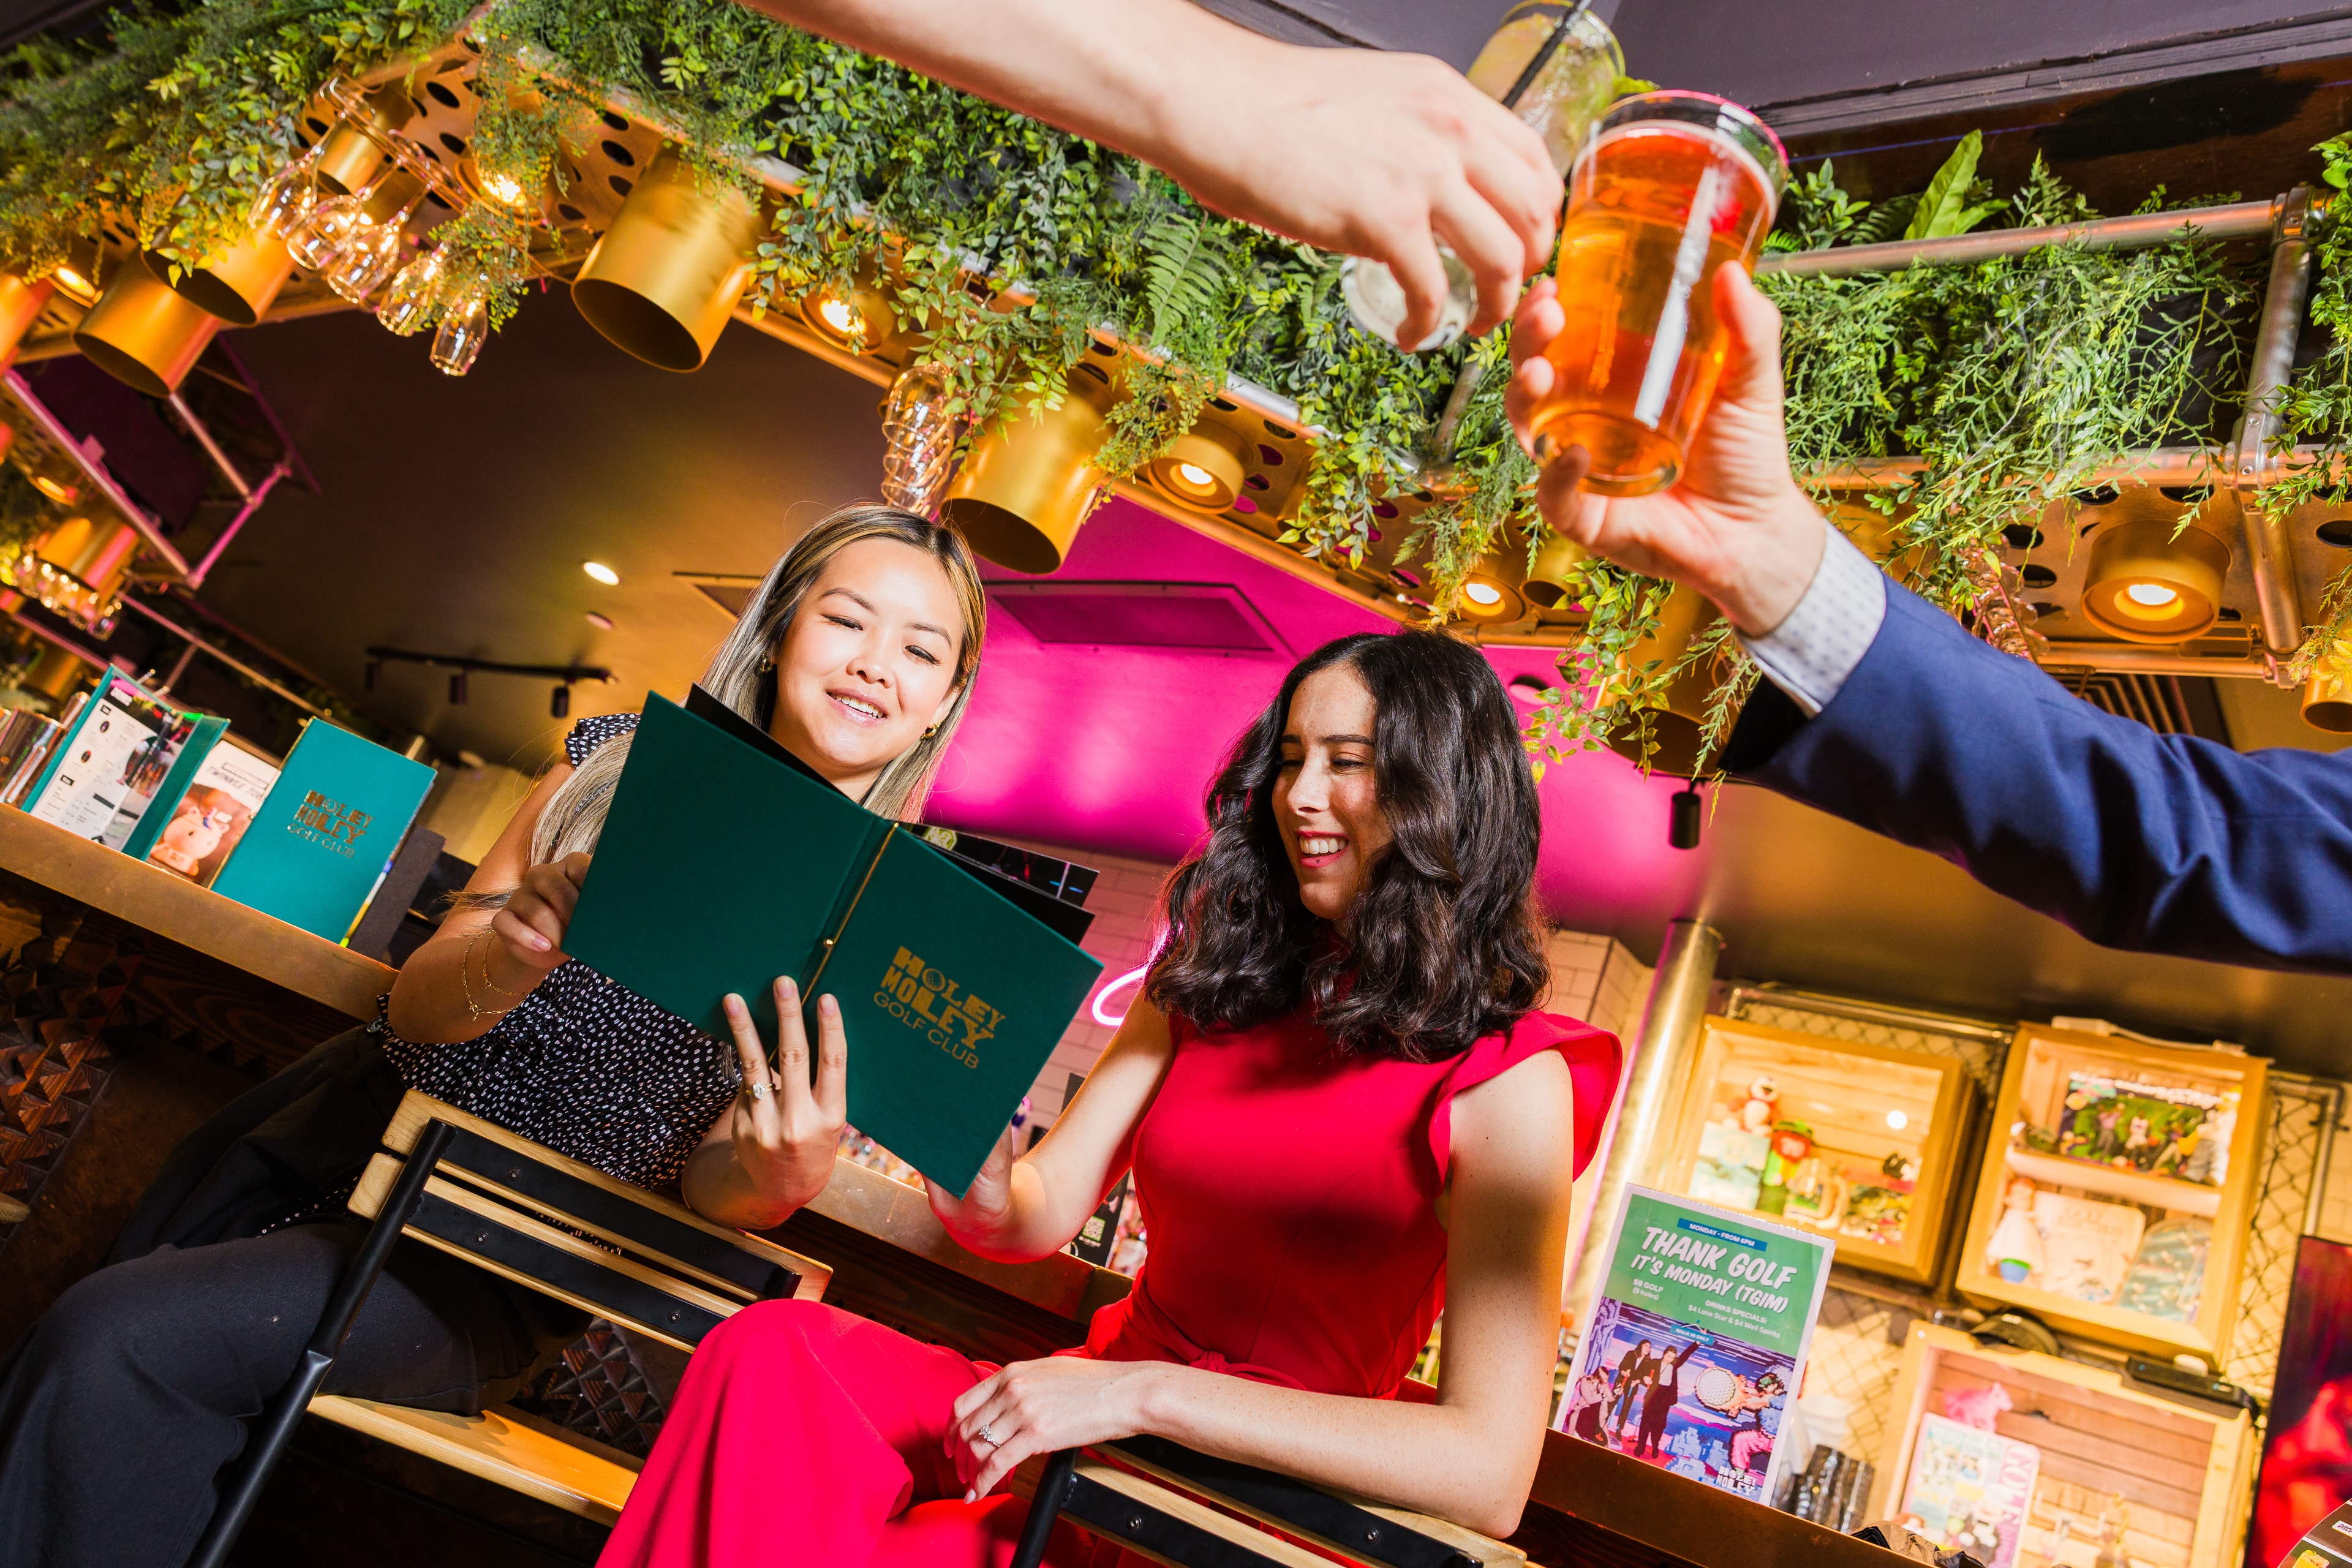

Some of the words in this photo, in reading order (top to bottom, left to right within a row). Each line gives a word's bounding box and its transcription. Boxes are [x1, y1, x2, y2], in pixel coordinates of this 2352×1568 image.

[293, 804, 366, 845] MOLEY
[303, 789, 374, 828] HOLEY
[287, 823, 322, 843] GOLF
[322, 838, 355, 858] CLUB
[892, 945, 1006, 1031] HOLEY
[880, 965, 995, 1050] MOLEY
[873, 991, 927, 1030] GOLF
[928, 1028, 979, 1069] CLUB
[1689, 1224, 1717, 1236] MONDAY
[1721, 1232, 1740, 1243] FROM
[1740, 1238, 1755, 1247] 6PM
[1642, 1226, 1727, 1270] THANK
[1728, 1253, 1798, 1289] GOLF
[1630, 1254, 1664, 1276] IT'S
[1664, 1264, 1735, 1296] MONDAY
[1735, 1284, 1789, 1313] (TGIM)
[1640, 1289, 1659, 1300] holes)
[1643, 1282, 1664, 1292] GOLF
[1697, 1307, 1713, 1317] Lone
[1714, 1313, 1727, 1321] Star
[1744, 1323, 1758, 1332] Well
[1759, 1327, 1781, 1338] Spirits
[1705, 1300, 1732, 1313] DRINKS
[1732, 1308, 1767, 1324] SPECIALS:
[1716, 1474, 1756, 1496] MOLEY
[1718, 1466, 1758, 1487] HOLEY
